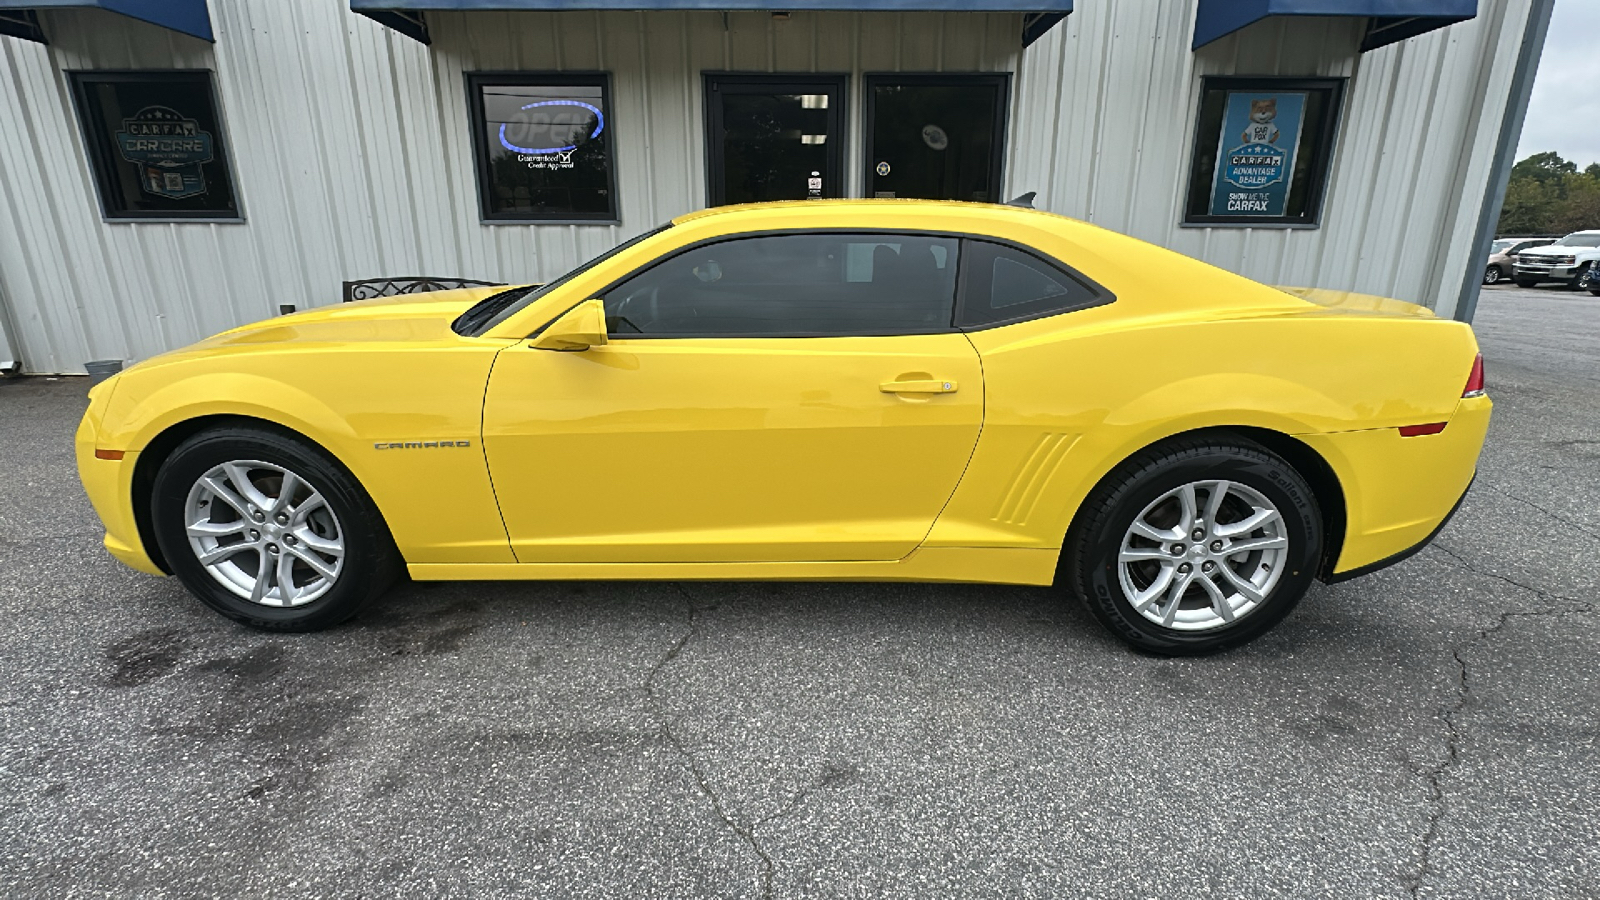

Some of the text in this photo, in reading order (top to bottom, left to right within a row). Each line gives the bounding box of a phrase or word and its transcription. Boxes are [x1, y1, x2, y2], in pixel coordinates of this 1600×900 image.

[130, 123, 195, 137] CARFAX
[507, 112, 590, 143] OPEN
[1253, 133, 1267, 141] FOX
[517, 154, 559, 162] Guaranteed
[1232, 156, 1280, 166] CARFAX
[548, 161, 574, 171] Approval
[1232, 167, 1276, 176] ADVANTAGE
[1238, 176, 1267, 184] DEALER
[1228, 192, 1248, 200] SHOW
[1227, 200, 1269, 211] CARFAX
[374, 440, 471, 450] CAMARO
